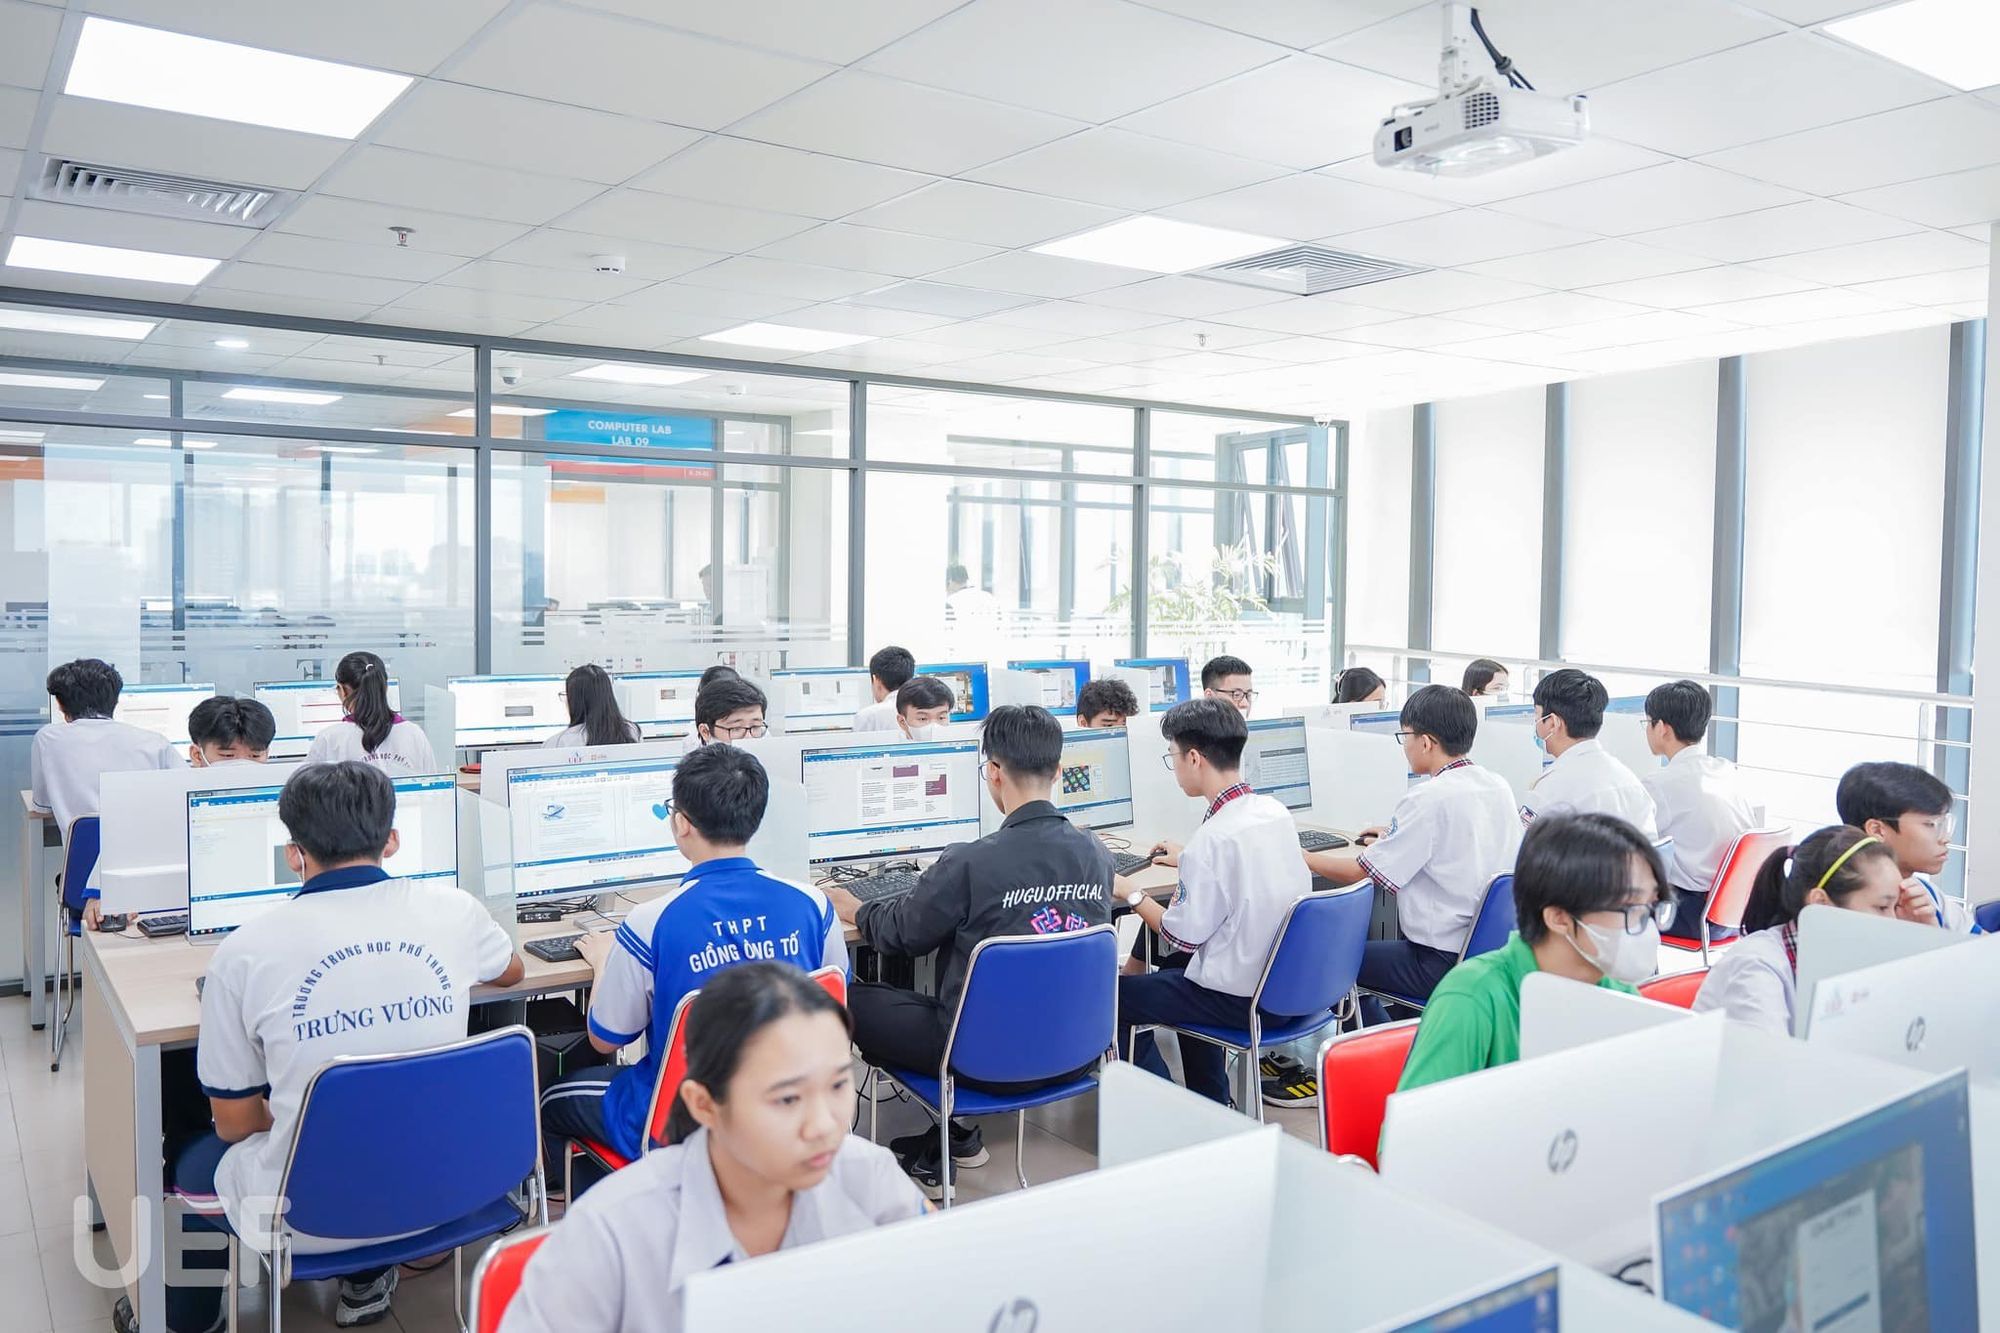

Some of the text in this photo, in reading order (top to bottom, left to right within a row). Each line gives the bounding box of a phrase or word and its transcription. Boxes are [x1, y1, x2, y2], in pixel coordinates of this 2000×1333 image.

[588, 420, 672, 435] COMPUTER LAB
[611, 435, 649, 447] LAB 09
[713, 916, 766, 936] THPT
[320, 944, 362, 970] TRUNG
[366, 941, 391, 955] HỌC
[689, 942, 740, 973] GIỒNG
[780, 930, 800, 956] TỐ
[293, 995, 453, 1042] TRƯNG VƯƠNG
